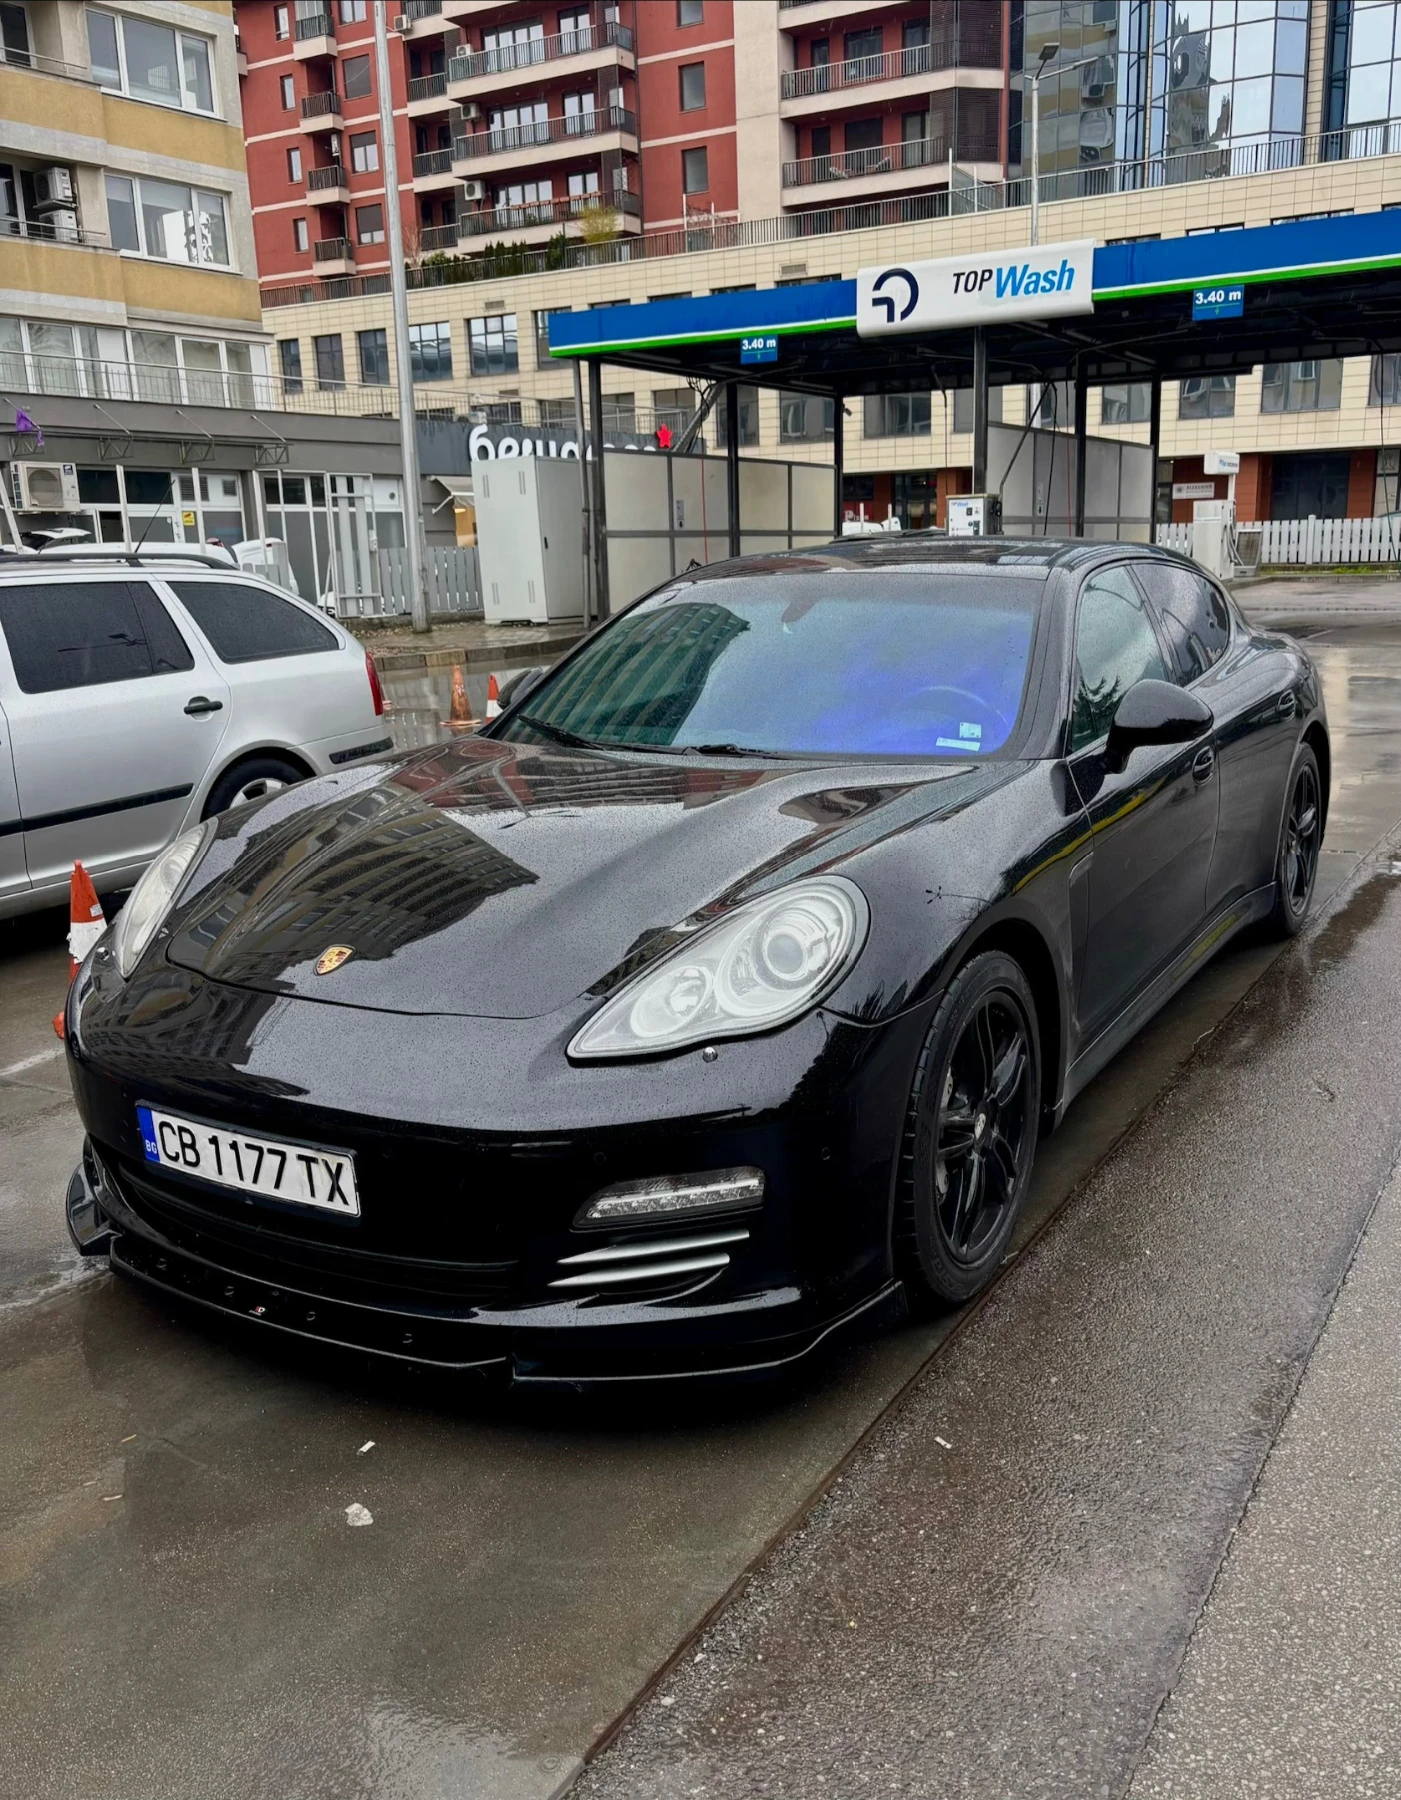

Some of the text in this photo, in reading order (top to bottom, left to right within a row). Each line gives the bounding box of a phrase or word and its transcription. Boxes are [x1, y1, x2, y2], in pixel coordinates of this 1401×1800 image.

[1195, 290, 1242, 305] 3.40 m
[742, 338, 777, 350] 3.40 m
[145, 1140, 158, 1154] BG
